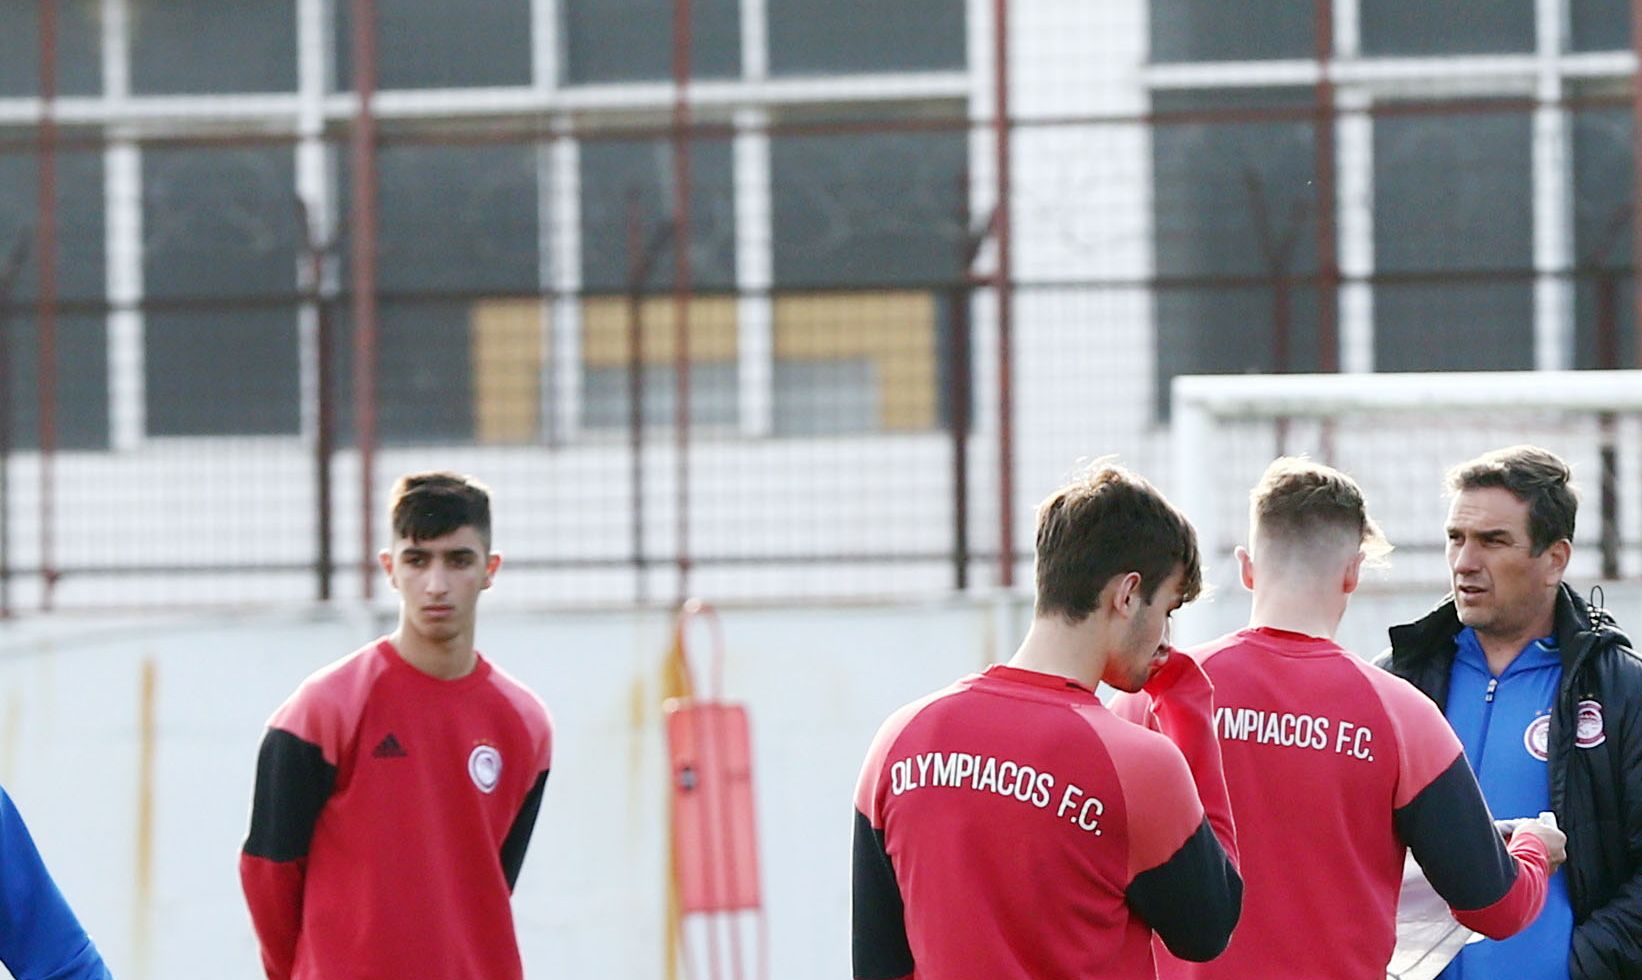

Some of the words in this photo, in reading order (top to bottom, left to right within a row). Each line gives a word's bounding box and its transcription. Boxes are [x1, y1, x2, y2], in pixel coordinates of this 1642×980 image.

[1213, 707, 1330, 750] YMPIACOS
[1335, 720, 1374, 762] F.C.
[890, 752, 1055, 808] OLYMPIACOS
[1057, 784, 1104, 836] F.C.
